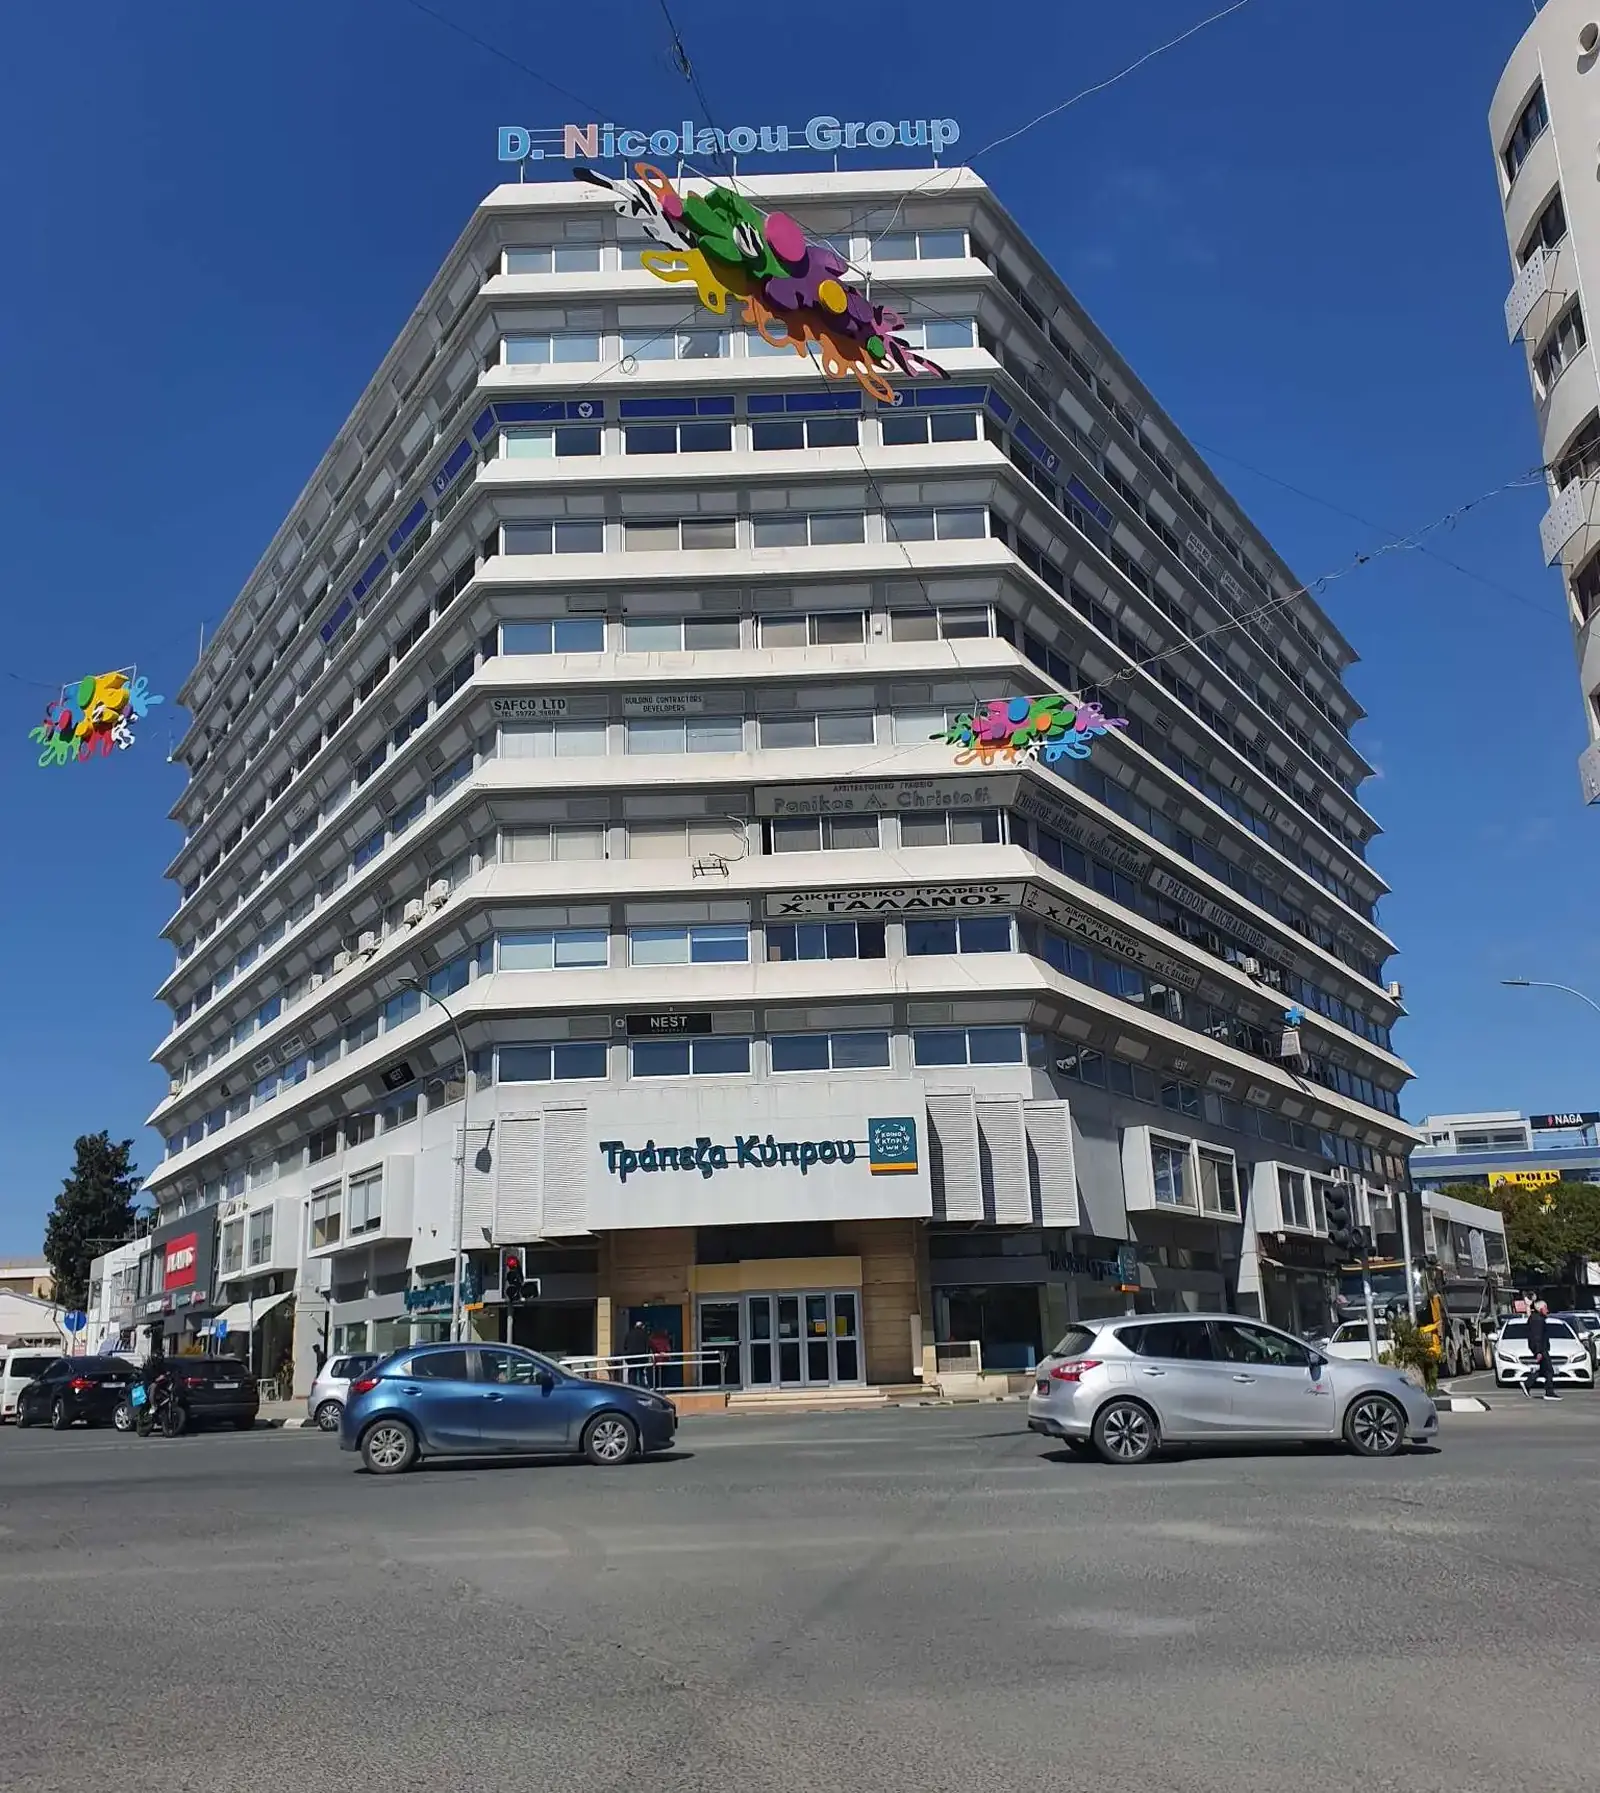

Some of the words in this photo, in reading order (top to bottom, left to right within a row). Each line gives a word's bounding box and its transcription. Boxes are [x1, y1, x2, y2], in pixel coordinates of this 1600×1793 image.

[498, 126, 544, 161] D.
[564, 120, 788, 159] Nicolaou
[805, 115, 960, 153] Group
[494, 699, 536, 711] SAFCO
[542, 699, 566, 710] LTD
[643, 704, 685, 713] DEVELOPERS
[774, 794, 854, 813] Panikos
[896, 787, 990, 808] Christofi
[791, 890, 906, 901] ΔΙΚΗΓΟΡΙΚΟ
[916, 886, 998, 896] ΓΡΑΦΕΙΟ
[827, 894, 1011, 912] ΓΑΛΑΝΟΣ
[1064, 906, 1109, 933] ΔΙΚΗΓΟΡΙΚΟ
[1066, 917, 1148, 963] ΓΑΛΑΝΟΣ
[650, 1016, 688, 1028] NEST
[1554, 1113, 1583, 1125] NAGA
[599, 1137, 728, 1183] Τράπεζα
[735, 1135, 856, 1175] Κύπρου
[1515, 1172, 1559, 1182] POLIS
